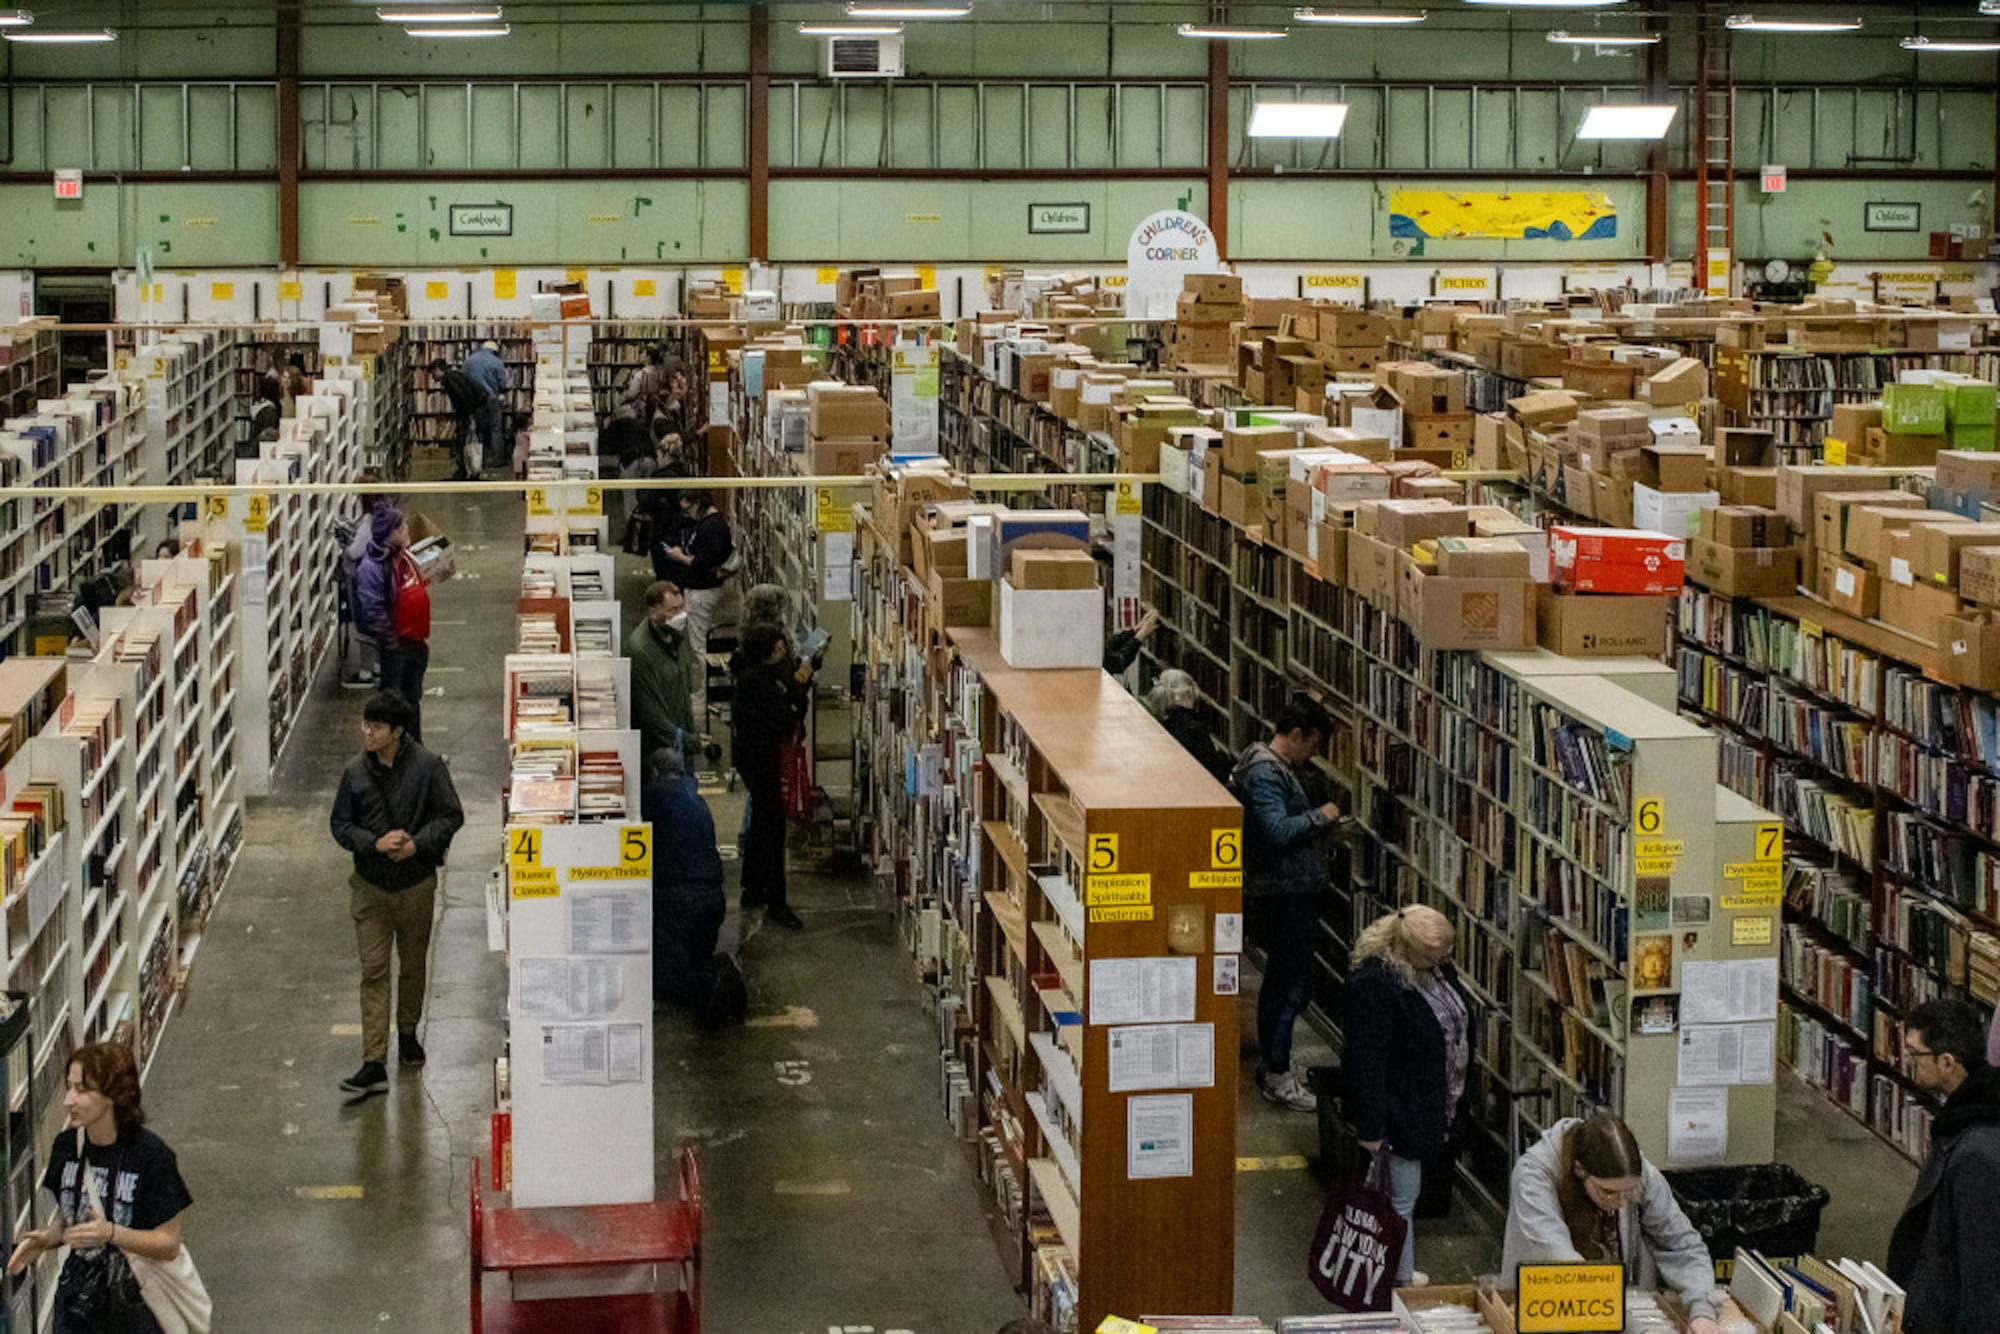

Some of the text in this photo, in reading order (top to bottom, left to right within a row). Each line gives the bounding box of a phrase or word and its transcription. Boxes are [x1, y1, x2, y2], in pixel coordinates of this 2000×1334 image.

[1137, 217, 1208, 246] CHILDREN'S
[1146, 248, 1199, 261] CORNER
[1307, 276, 1359, 287] CLASSICS
[1444, 277, 1486, 288] FICTION
[1453, 451, 1465, 468] 8
[531, 488, 601, 505] 4 5
[819, 490, 831, 506] 5
[213, 497, 263, 515] 3 4
[1600, 638, 1646, 647] ROLLAND
[1639, 801, 1660, 832] 6
[514, 829, 648, 863] 4 5
[1216, 832, 1238, 865] 6
[1761, 827, 1779, 857] 7
[1092, 837, 1115, 869] 5
[1725, 864, 1778, 876] Psychology
[1197, 872, 1241, 885] Religion
[513, 884, 557, 896] Classics
[1091, 891, 1146, 903] Spirituality
[1725, 895, 1776, 906] Philosophy
[1091, 908, 1150, 921] Westerns
[774, 1061, 811, 1085] 5
[1319, 1233, 1385, 1305] CITY
[1526, 1271, 1615, 1285] Non-DC/Marvel
[1526, 1299, 1615, 1318] COMICS
